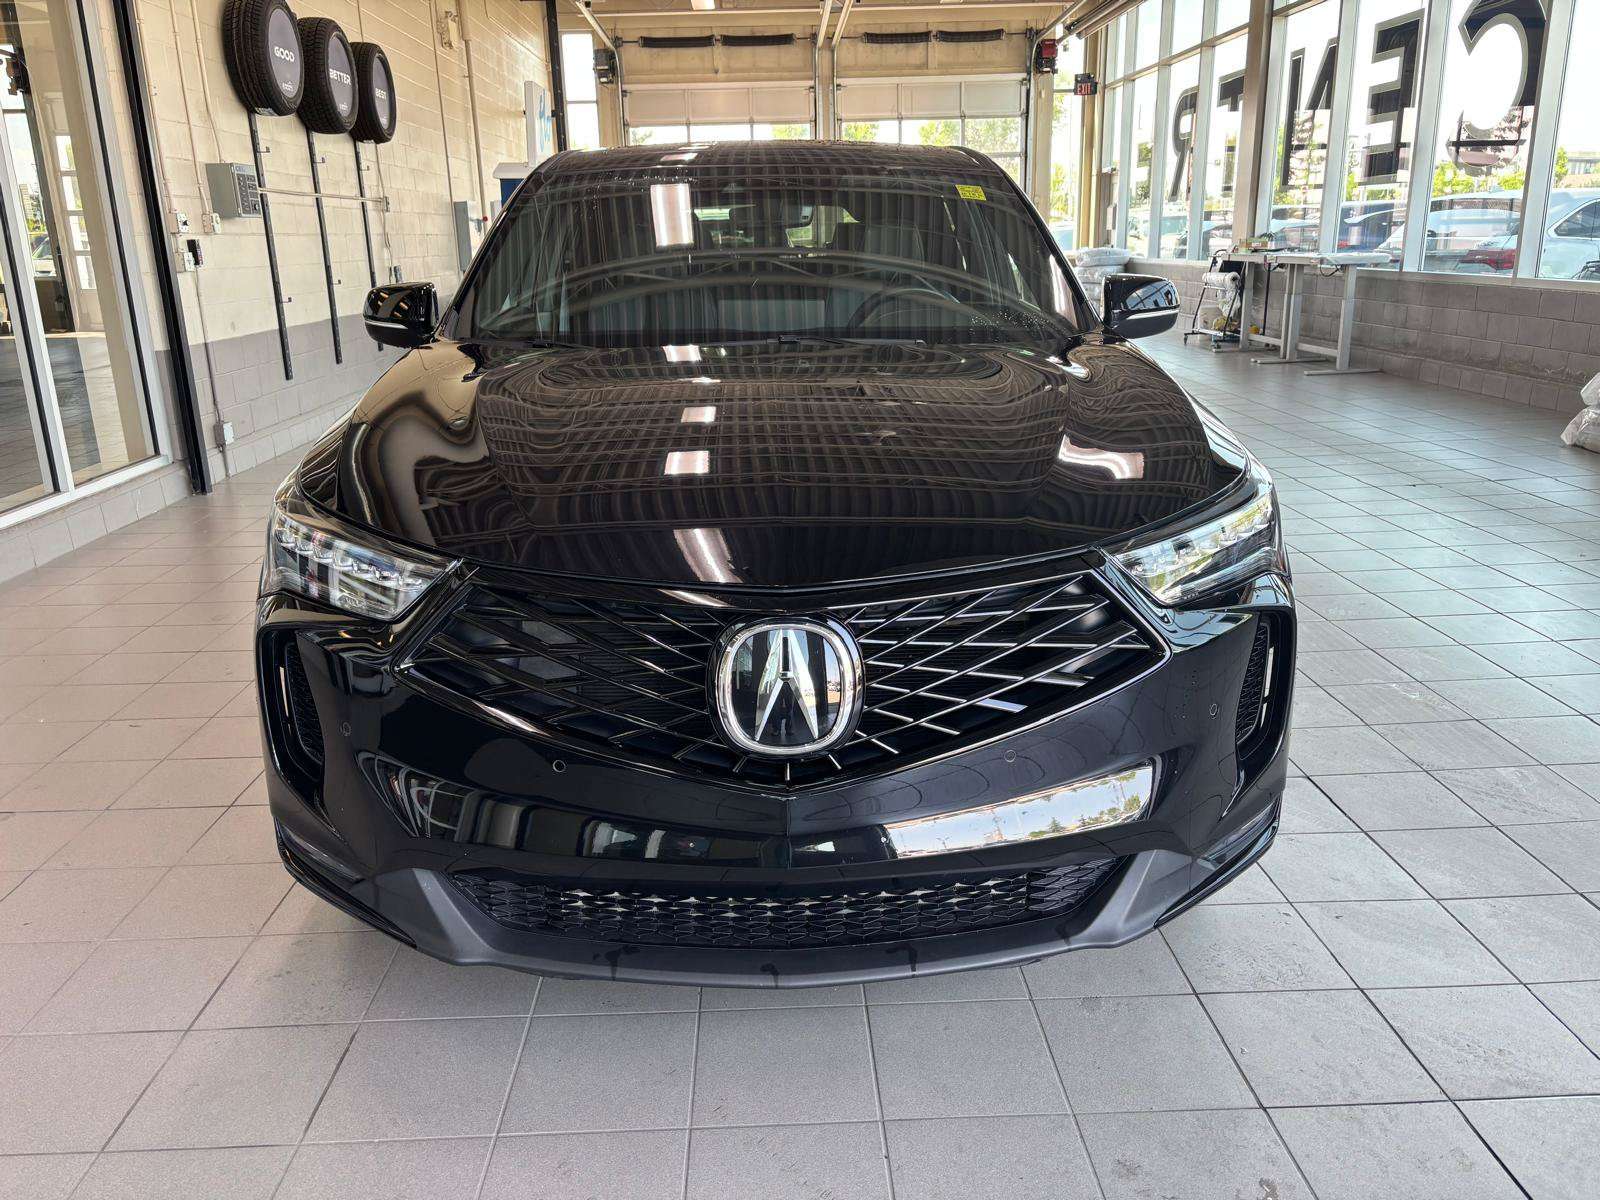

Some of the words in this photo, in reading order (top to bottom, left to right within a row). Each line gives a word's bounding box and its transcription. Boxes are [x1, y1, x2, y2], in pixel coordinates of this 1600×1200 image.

[274, 46, 295, 63] GOOD
[329, 68, 351, 85] BETTER
[1077, 83, 1092, 95] EXIT
